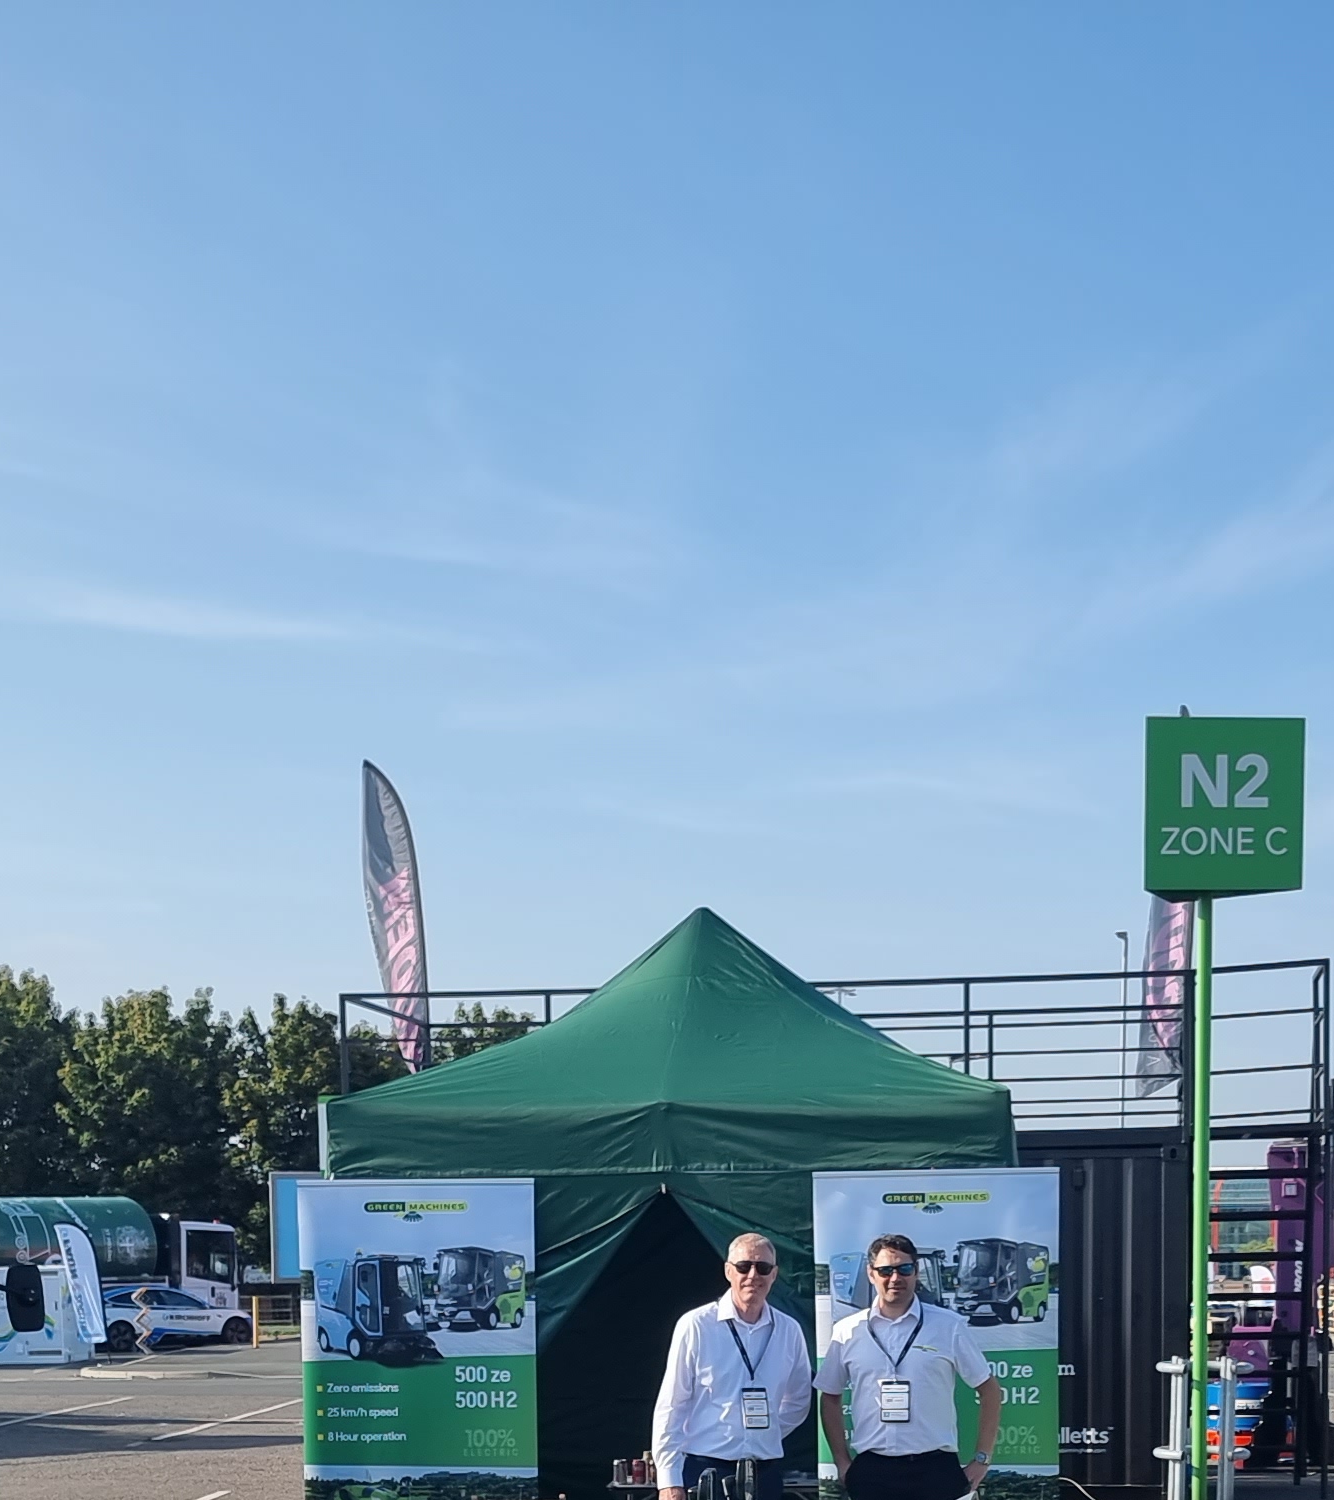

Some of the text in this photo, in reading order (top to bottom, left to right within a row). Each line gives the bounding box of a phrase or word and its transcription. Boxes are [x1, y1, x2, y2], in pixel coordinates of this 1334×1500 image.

[1180, 753, 1270, 808] N2
[1160, 826, 1289, 856] ZONE C
[367, 1203, 466, 1212] GREEN MACHINES
[885, 1193, 988, 1203] GREEN MACHINES
[454, 1365, 512, 1384] 500 ze
[986, 1360, 1034, 1379] 00 ze
[326, 1382, 400, 1394] Zero emissions
[1011, 1386, 1040, 1405] H2
[454, 1390, 518, 1409] 500 H2
[327, 1406, 399, 1420] 25 km/h speed
[327, 1431, 407, 1445] 8 Hour operation
[465, 1428, 517, 1448] 100%
[996, 1425, 1038, 1446] 00%
[463, 1449, 520, 1458] ELECTRIC
[997, 1445, 1041, 1455] ECTRIC
